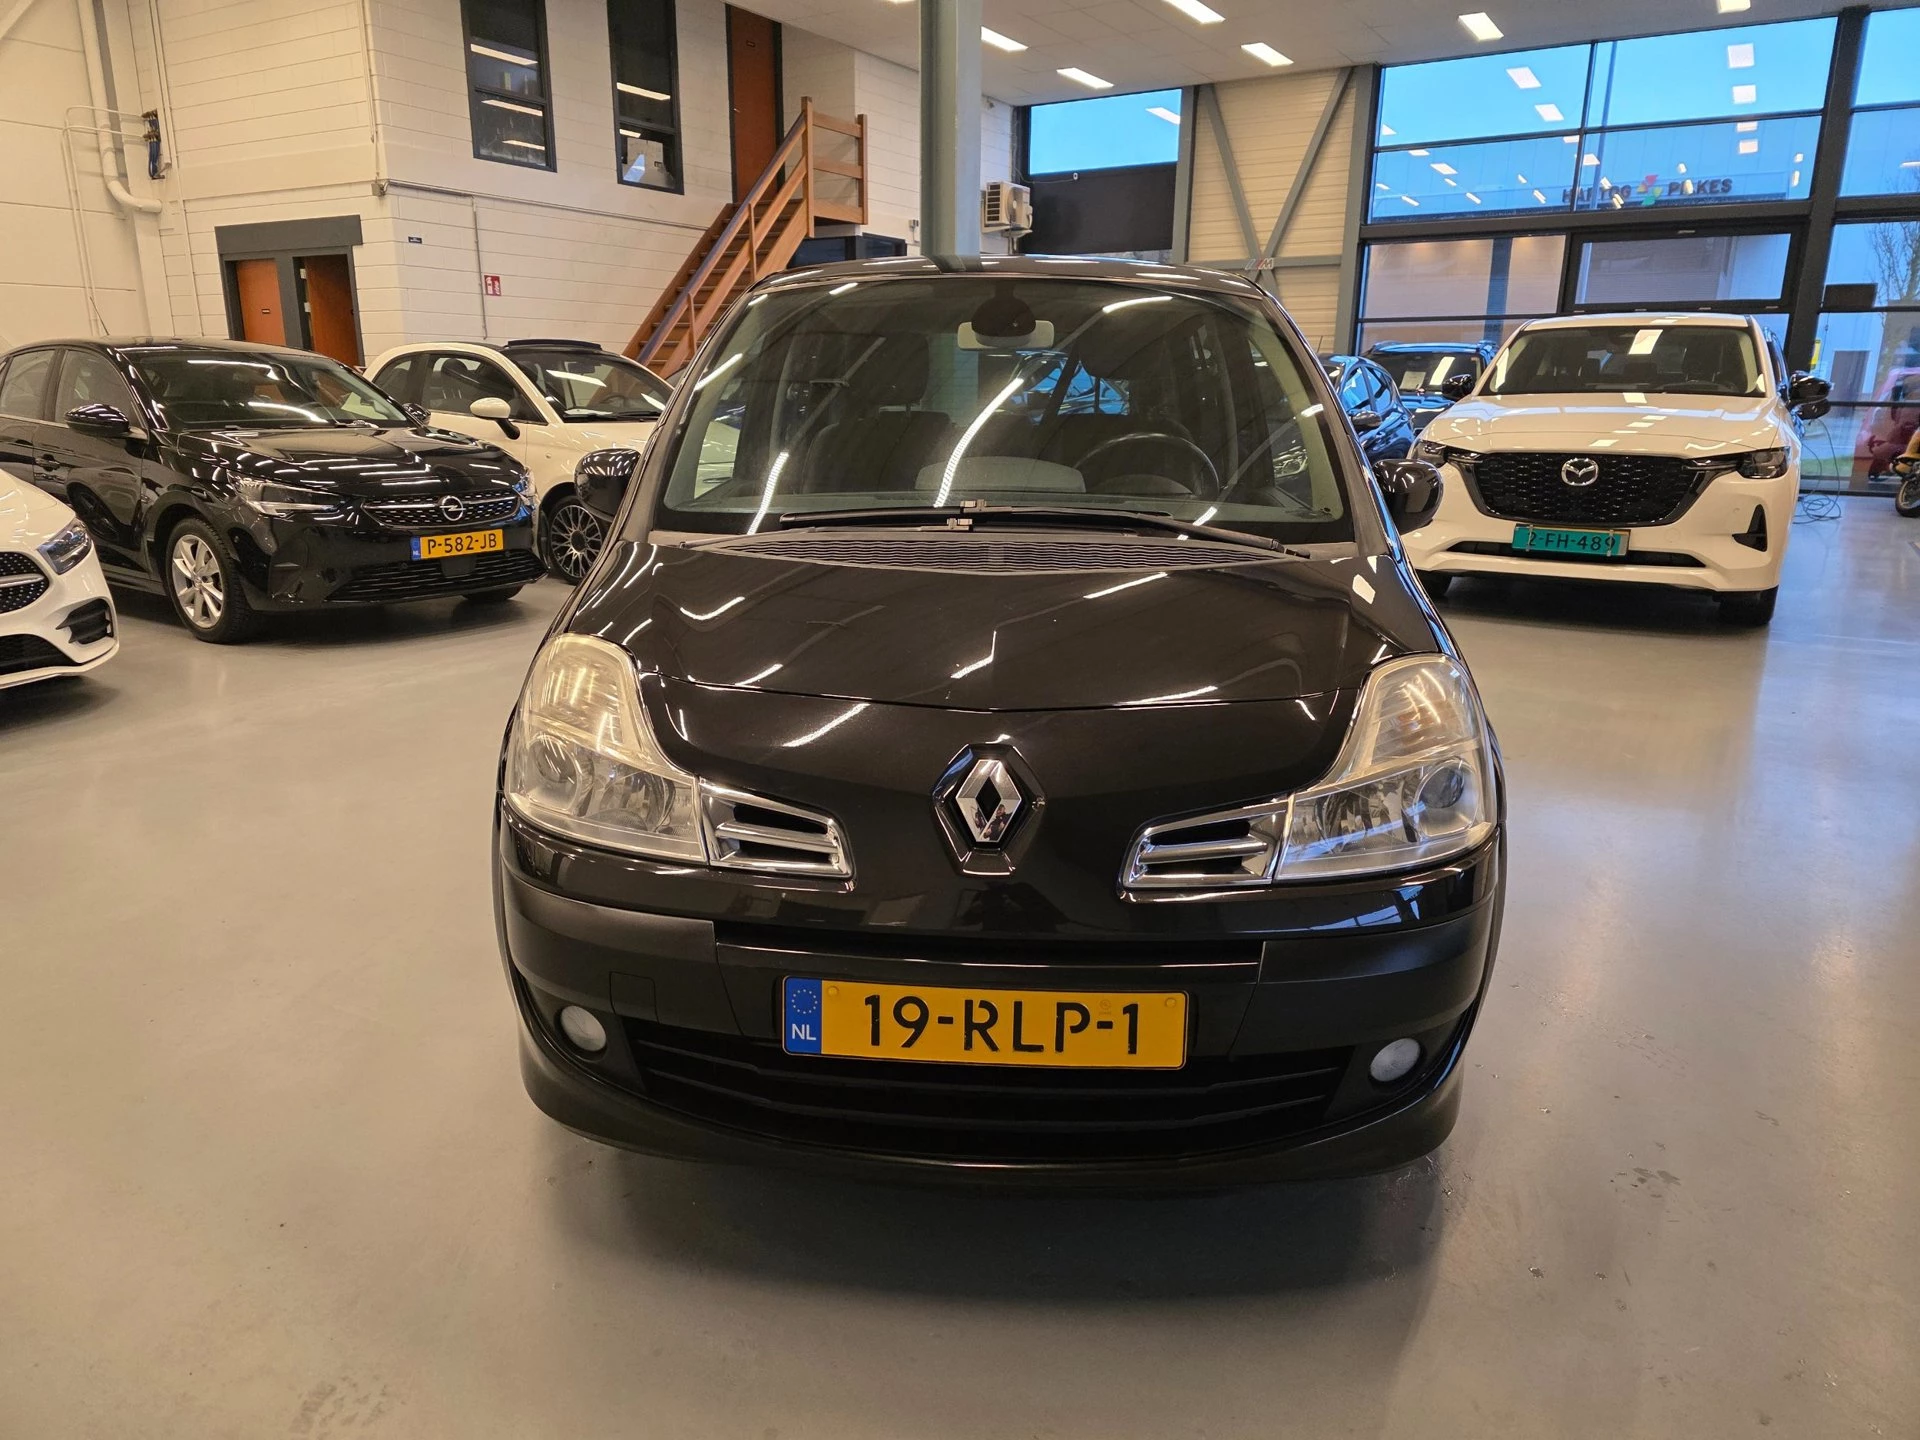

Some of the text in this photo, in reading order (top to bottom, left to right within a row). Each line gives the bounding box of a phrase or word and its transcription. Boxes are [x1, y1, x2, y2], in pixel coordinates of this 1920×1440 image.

[427, 533, 497, 554] P-582-JB
[791, 994, 1139, 1054] NL 19-RLP-1
